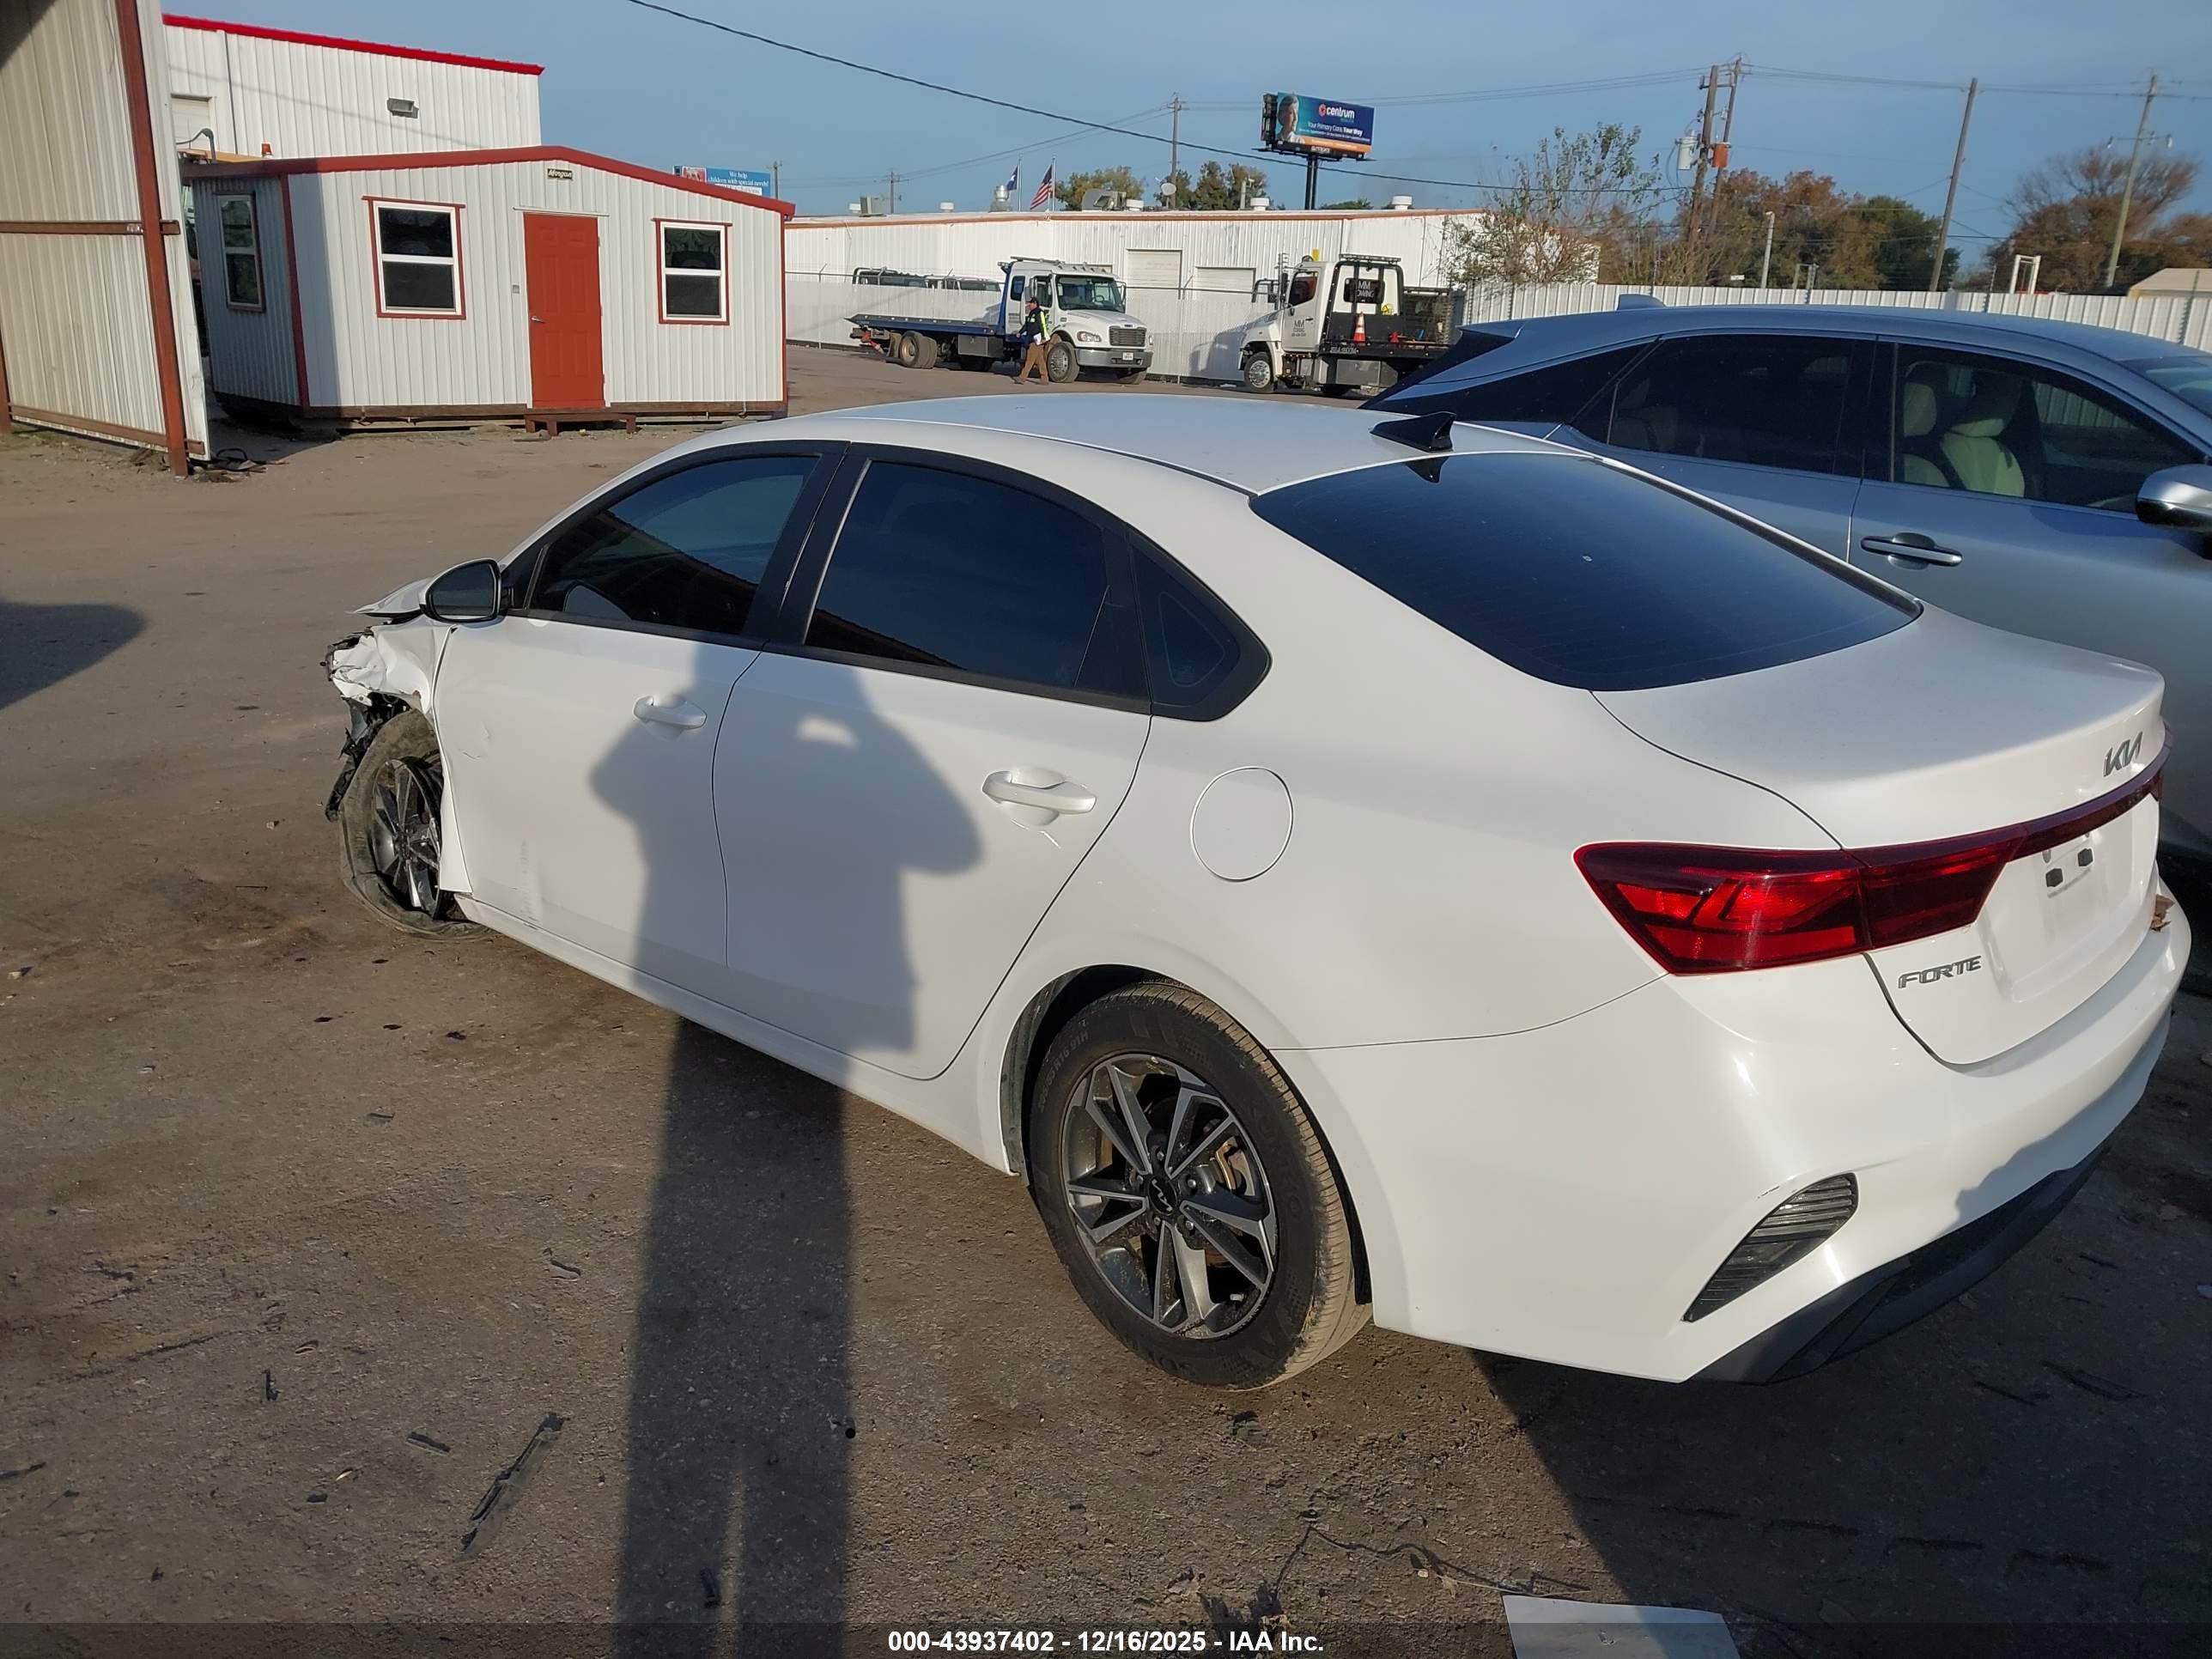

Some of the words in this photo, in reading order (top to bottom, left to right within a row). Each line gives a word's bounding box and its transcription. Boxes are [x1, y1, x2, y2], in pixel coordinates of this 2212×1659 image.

[1327, 106, 1355, 118] centrum
[1317, 123, 1332, 131] Primary
[1352, 128, 1364, 137] Way
[548, 169, 572, 179] Morgan
[1358, 281, 1371, 289] MM
[2103, 730, 2142, 777] KIA
[1898, 955, 1982, 988] FORTE
